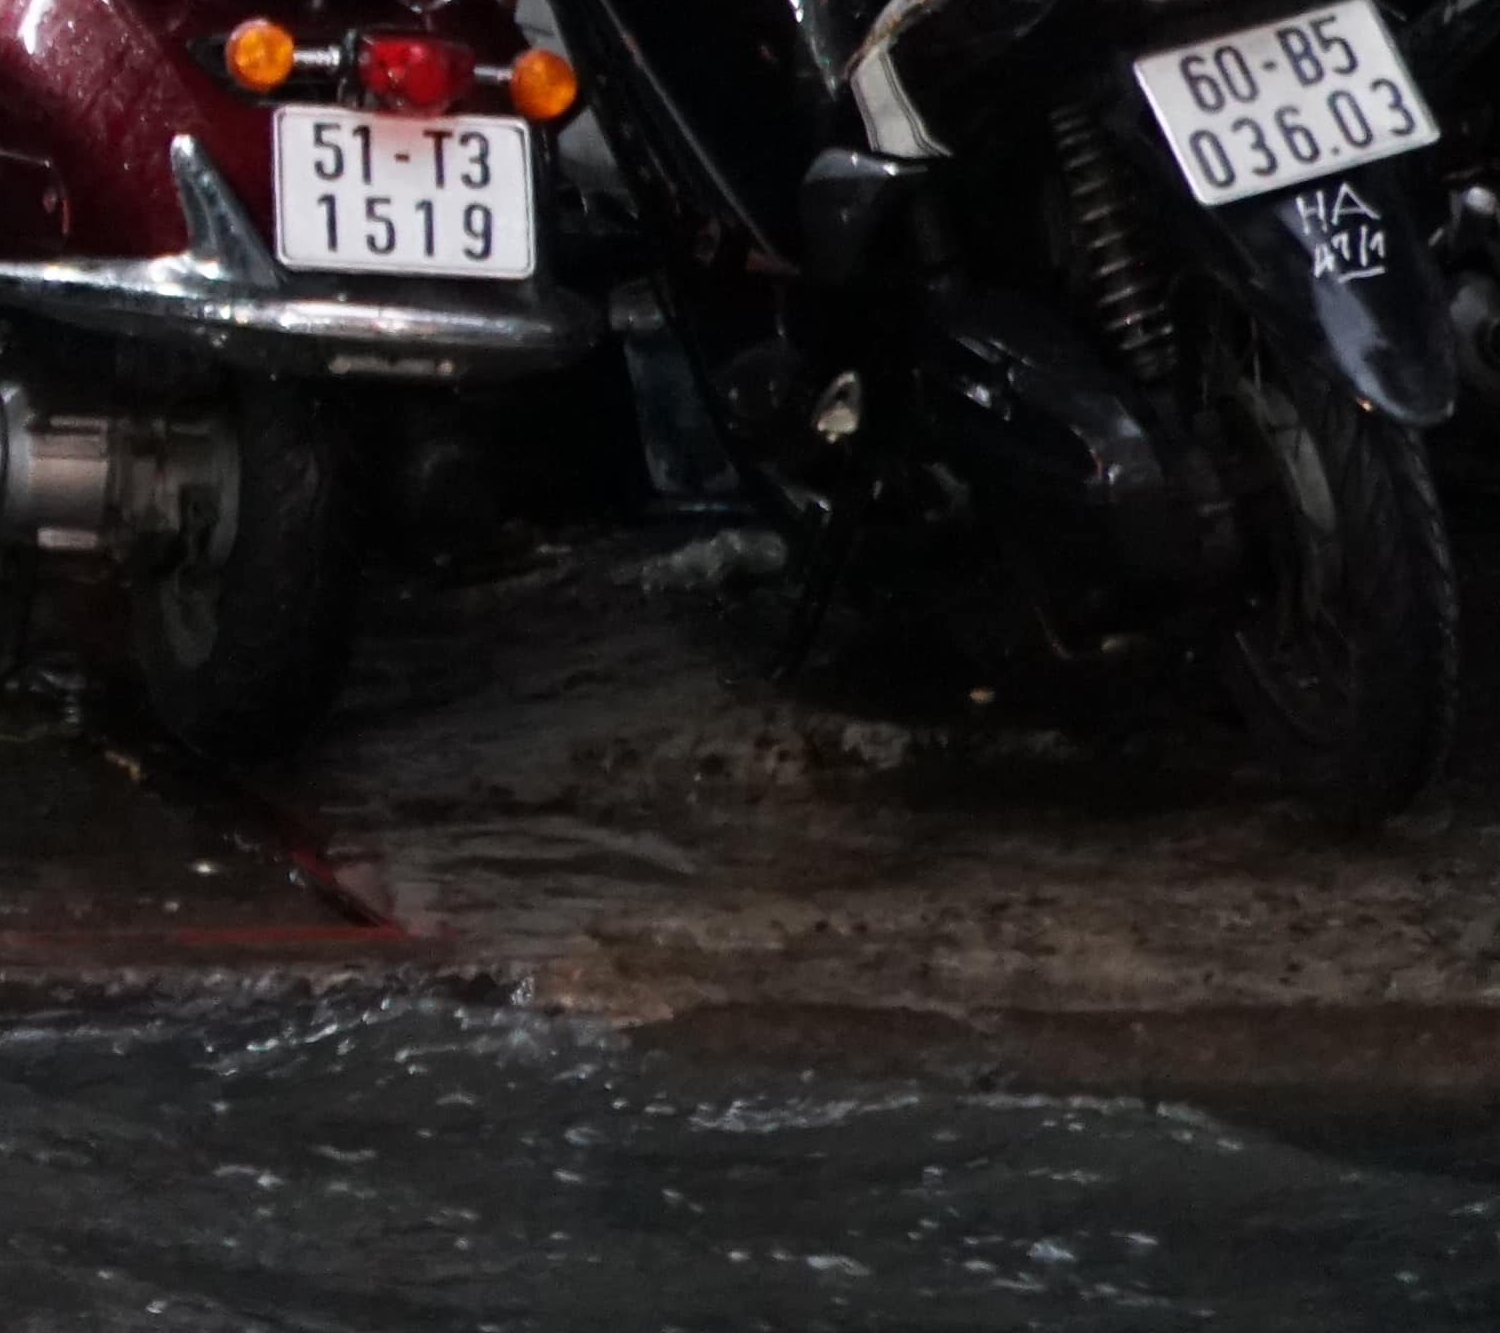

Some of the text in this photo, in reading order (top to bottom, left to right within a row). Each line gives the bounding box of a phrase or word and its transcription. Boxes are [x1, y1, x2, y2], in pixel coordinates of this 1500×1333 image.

[1179, 15, 1359, 114] 60-B5
[311, 122, 492, 190] 51-T3
[1189, 78, 1416, 190] 036.03
[317, 194, 494, 262] 1519
